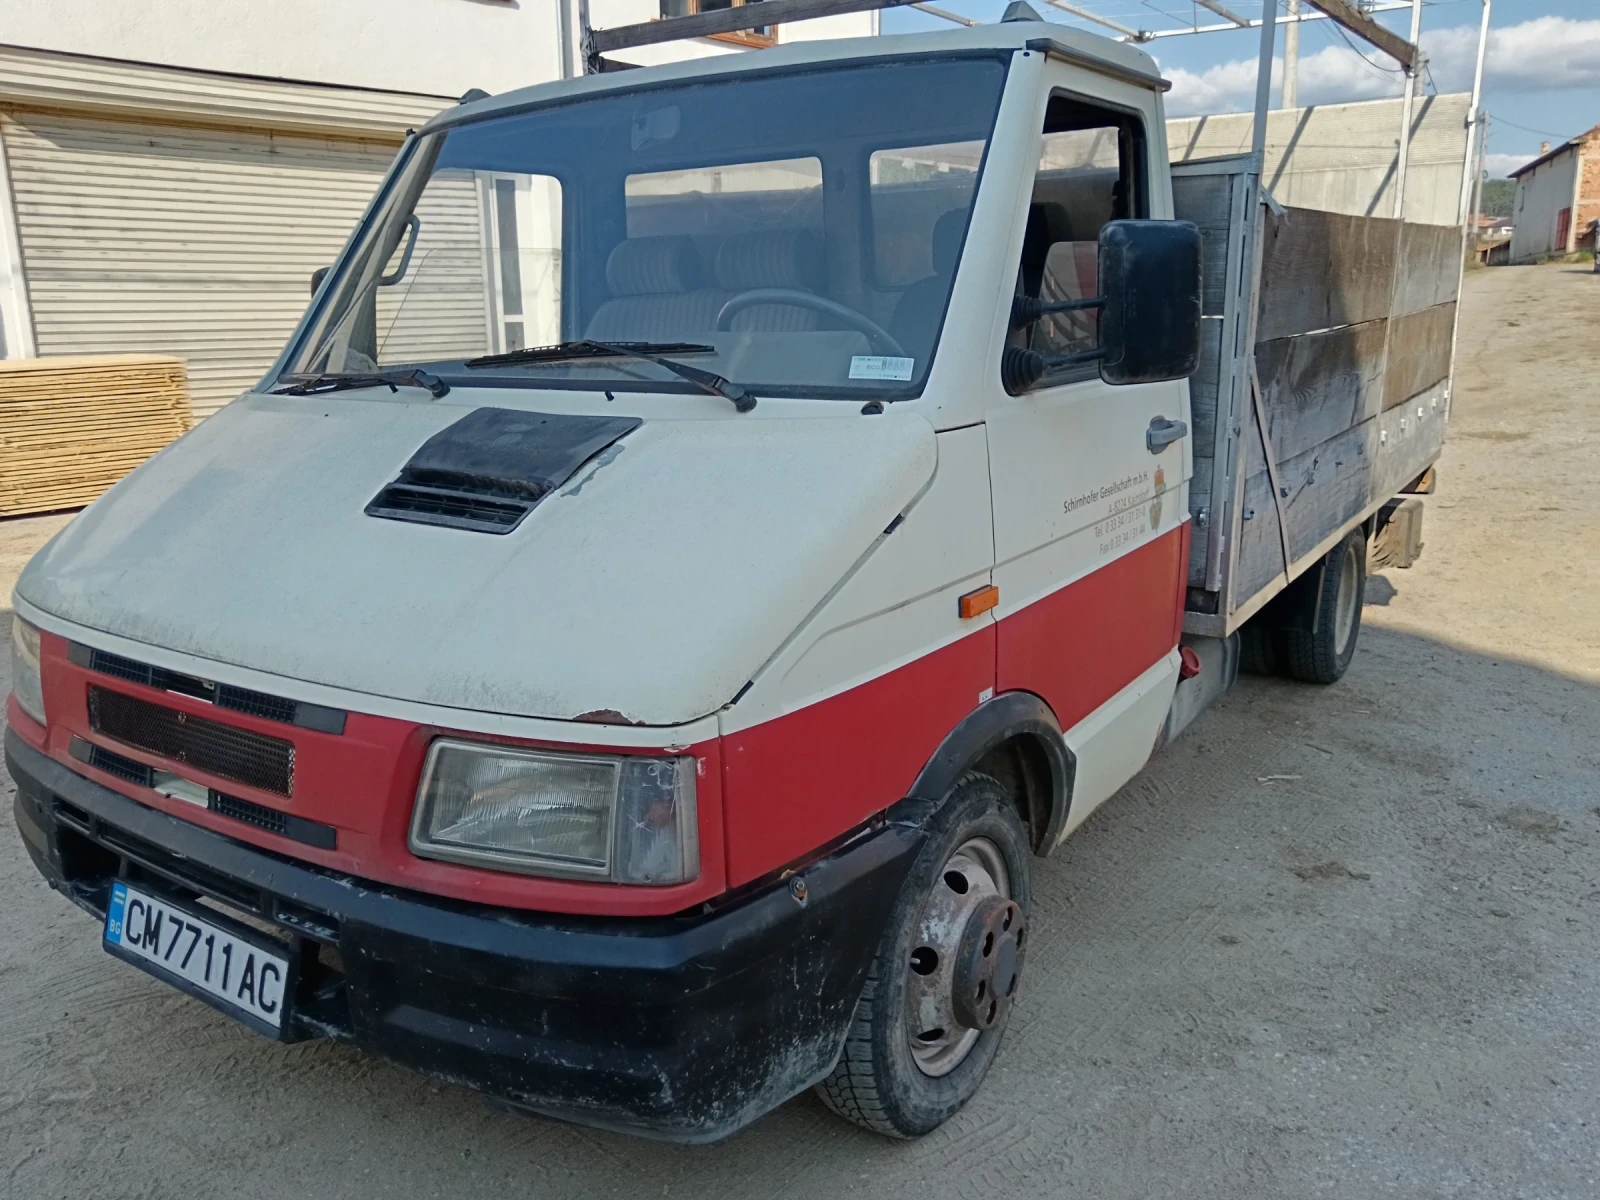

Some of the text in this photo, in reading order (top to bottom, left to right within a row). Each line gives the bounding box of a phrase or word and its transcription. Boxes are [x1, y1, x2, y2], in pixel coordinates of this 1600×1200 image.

[1063, 490, 1099, 514] Schirnhofer
[1100, 476, 1132, 499] Gesellschaft
[1099, 543, 1109, 556] Fax
[109, 919, 121, 935] BG
